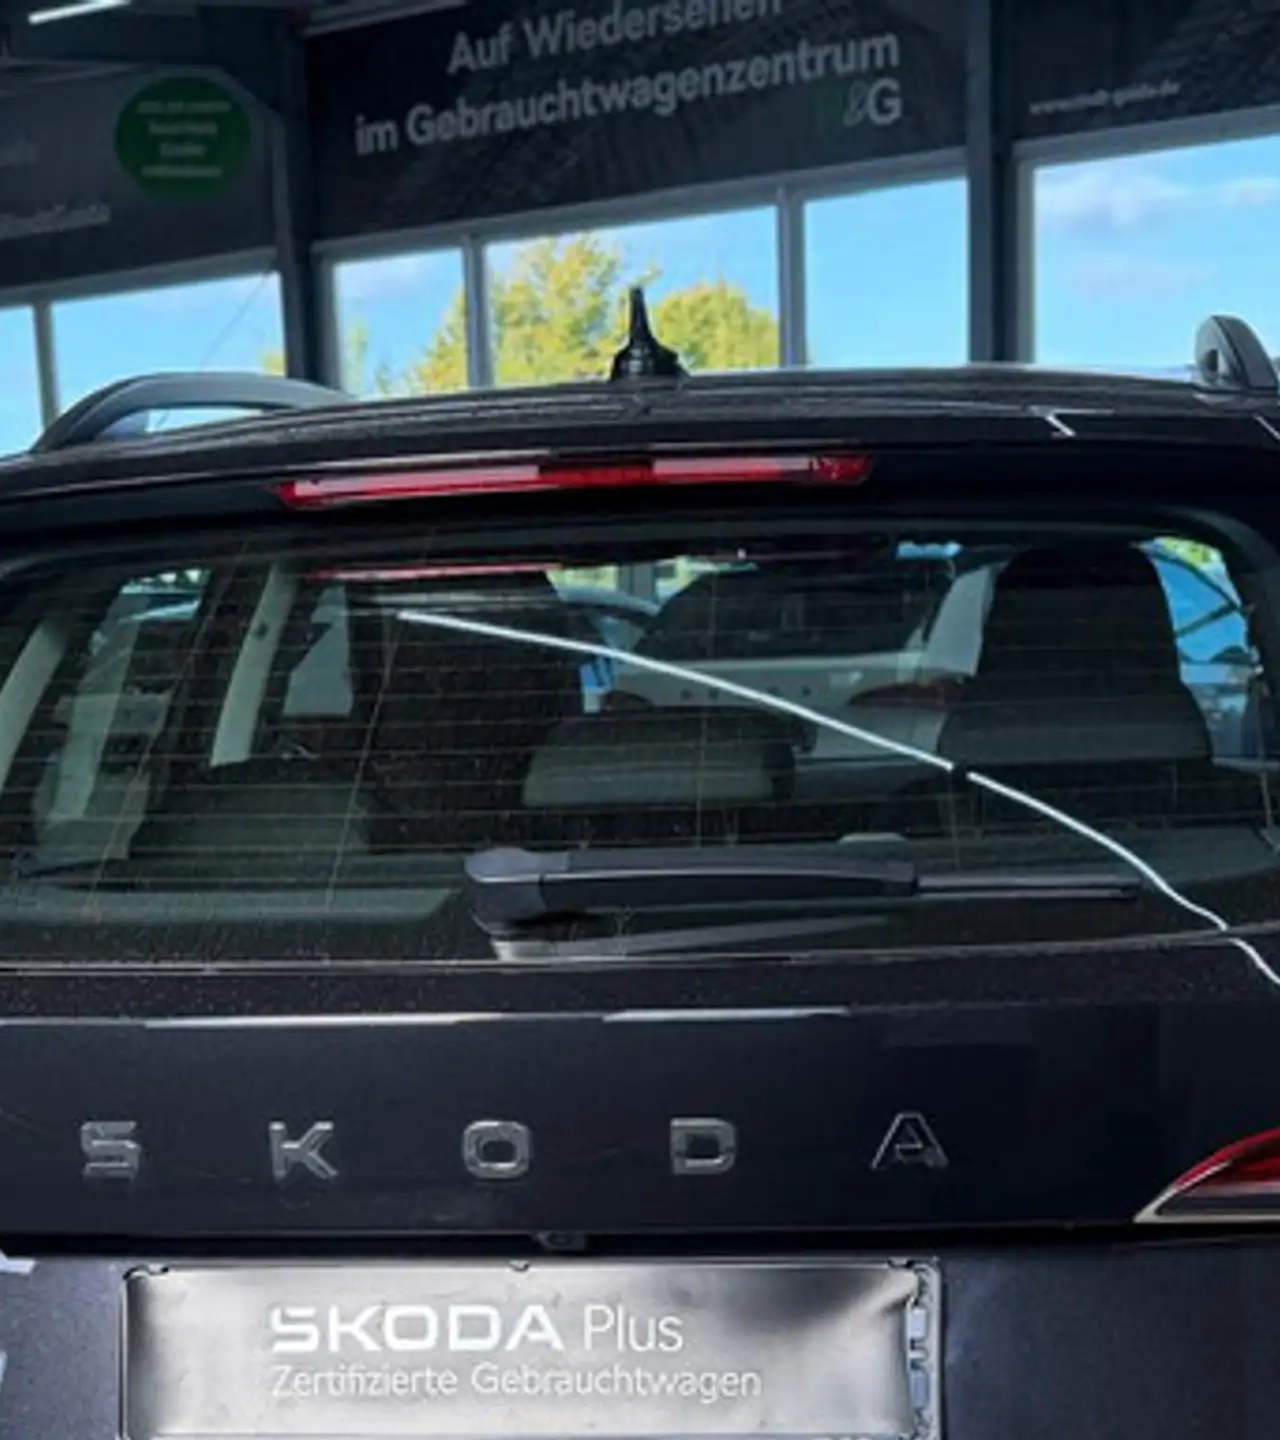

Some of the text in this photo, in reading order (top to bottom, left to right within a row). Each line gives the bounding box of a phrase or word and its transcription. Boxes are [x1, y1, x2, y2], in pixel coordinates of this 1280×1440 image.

[447, 21, 516, 75] Auf
[355, 32, 900, 156] im Gebrauchtwagenzentrum
[80, 1110, 949, 1181] SKODA
[270, 1302, 684, 1352] SKODA Plus
[271, 1360, 762, 1404] Zertifizierte Gebrauchtwagen
